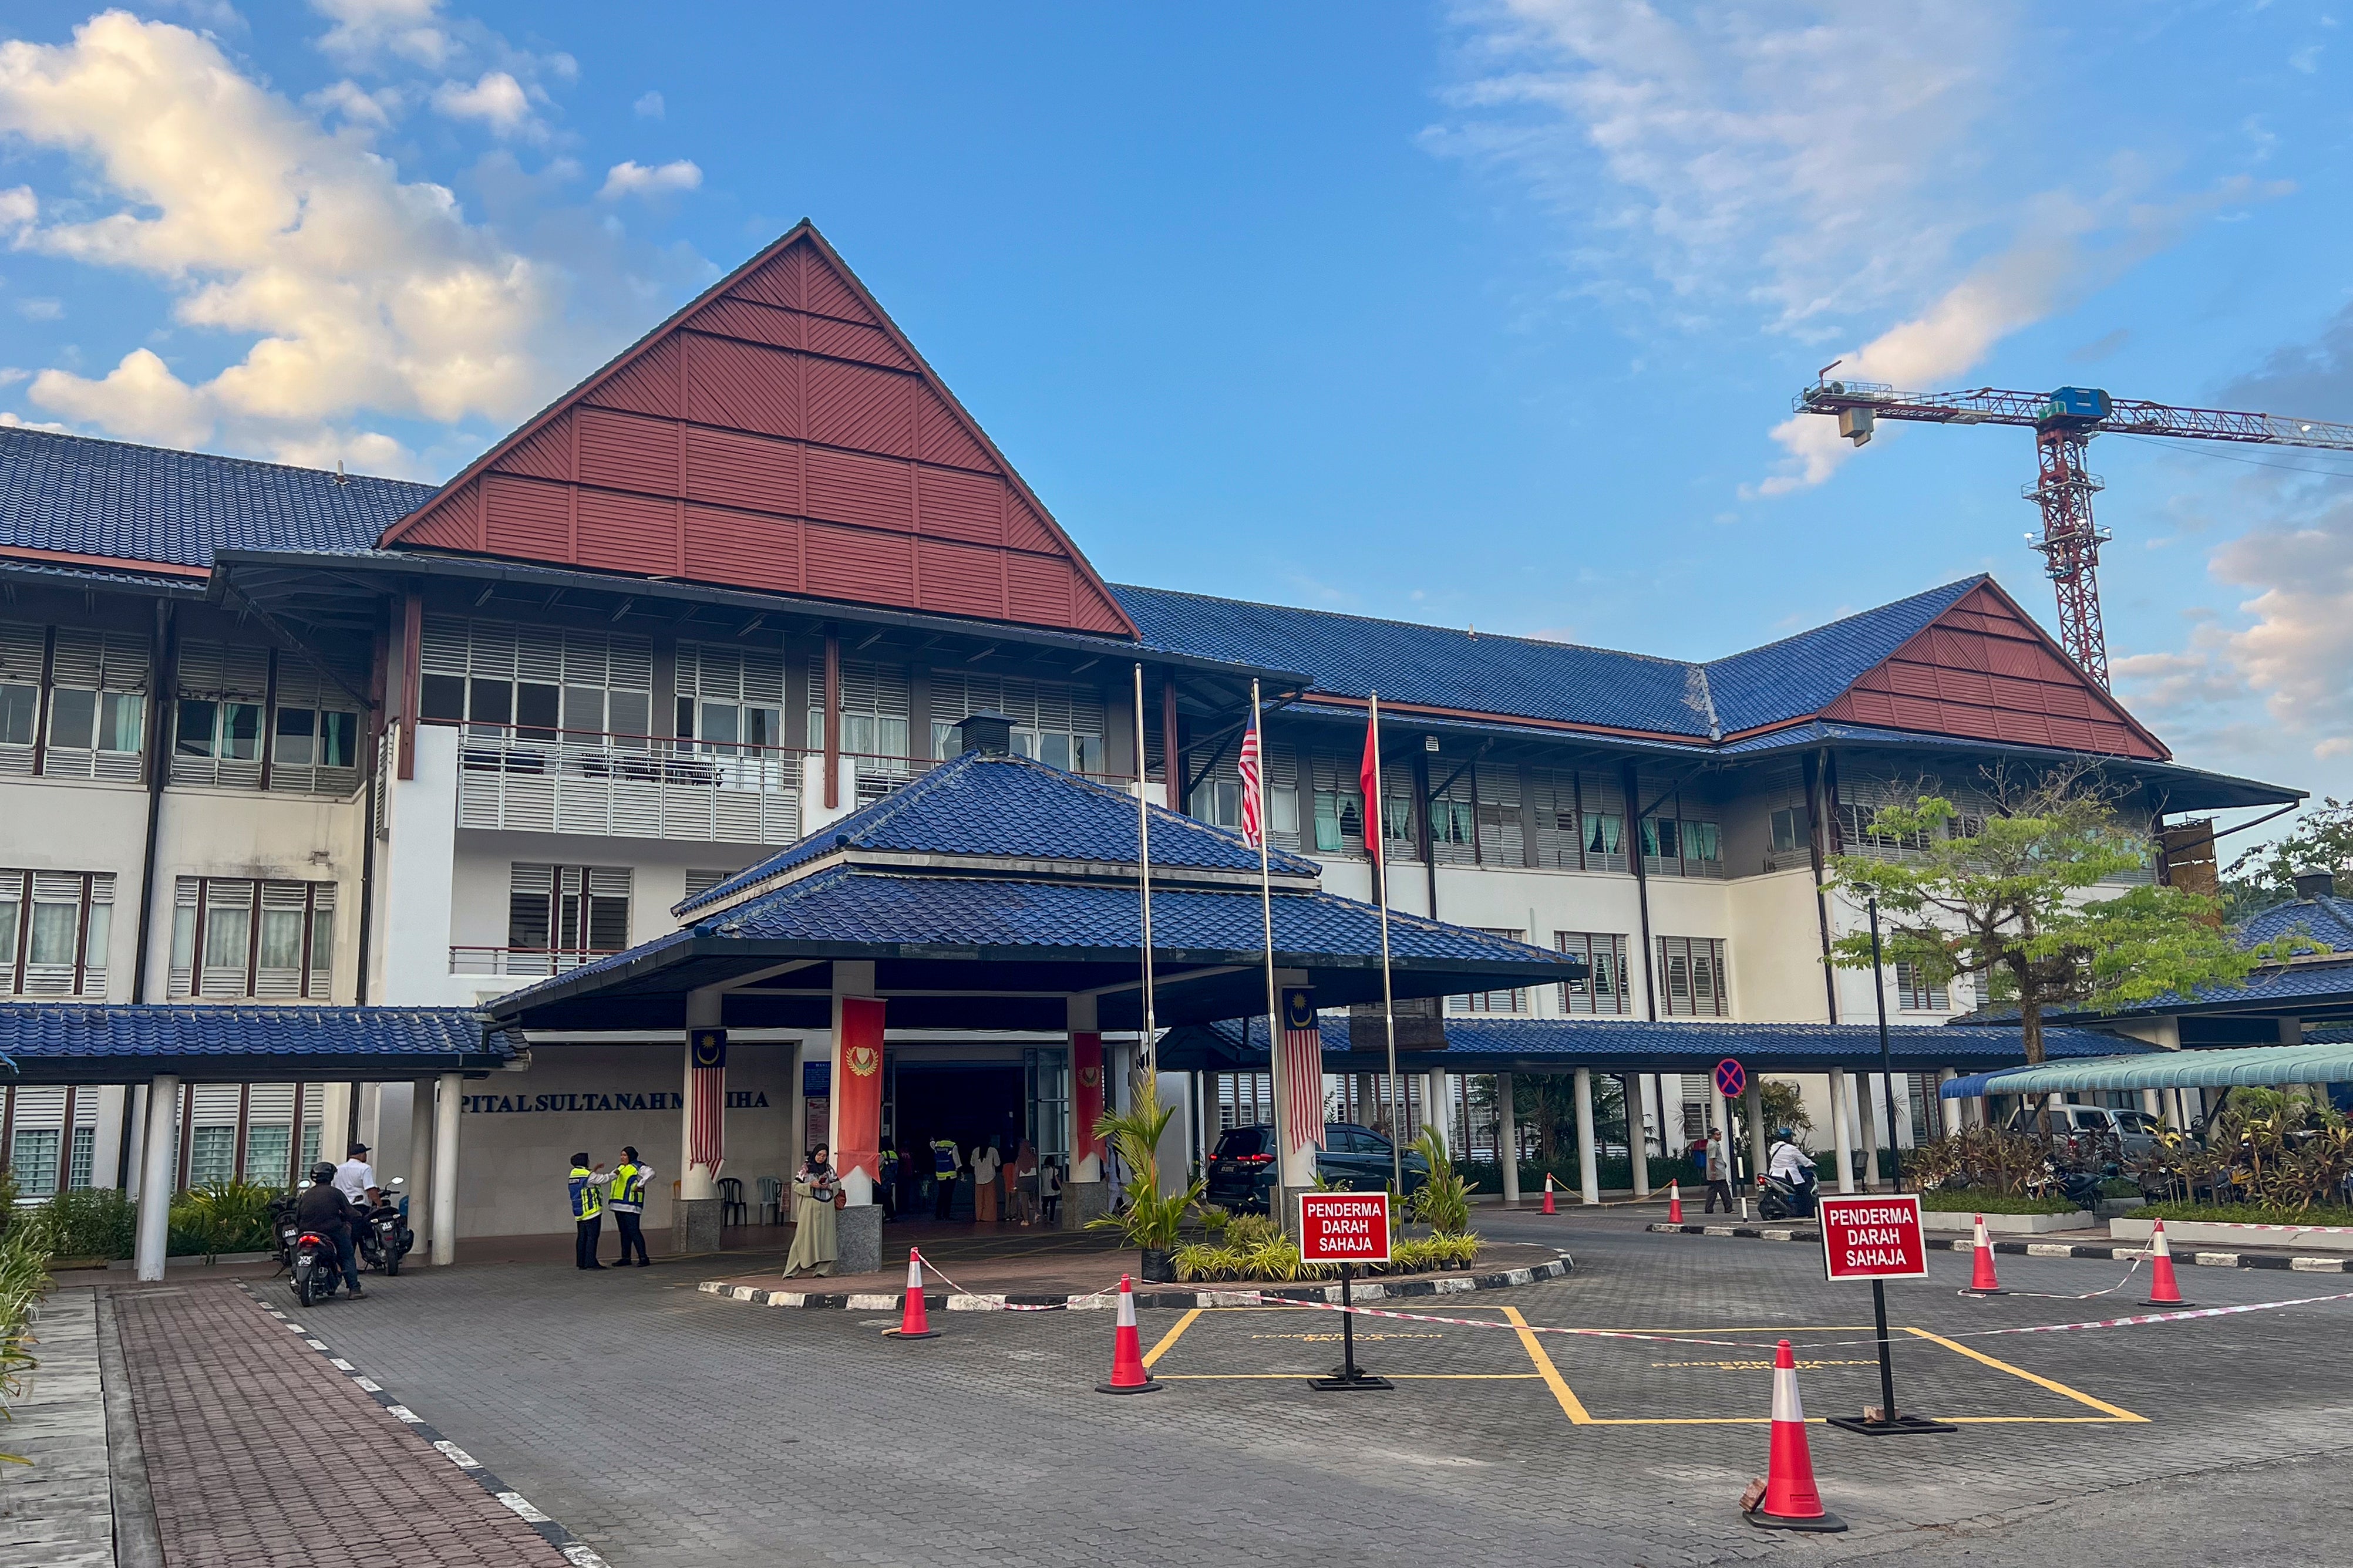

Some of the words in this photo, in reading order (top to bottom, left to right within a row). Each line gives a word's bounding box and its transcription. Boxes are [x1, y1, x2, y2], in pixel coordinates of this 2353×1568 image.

[462, 1095, 531, 1113] PITAL
[535, 1092, 668, 1111] SULTANAH
[670, 1091, 770, 1109] MIHA
[1308, 1202, 1382, 1218] PENDERMA
[1829, 1208, 1914, 1226] PENDERMA
[1322, 1220, 1369, 1234] DARAH
[1319, 1237, 1373, 1252] SAHAJA
[1847, 1228, 1900, 1246] DARAH
[1846, 1249, 1907, 1267] SAHAJA
